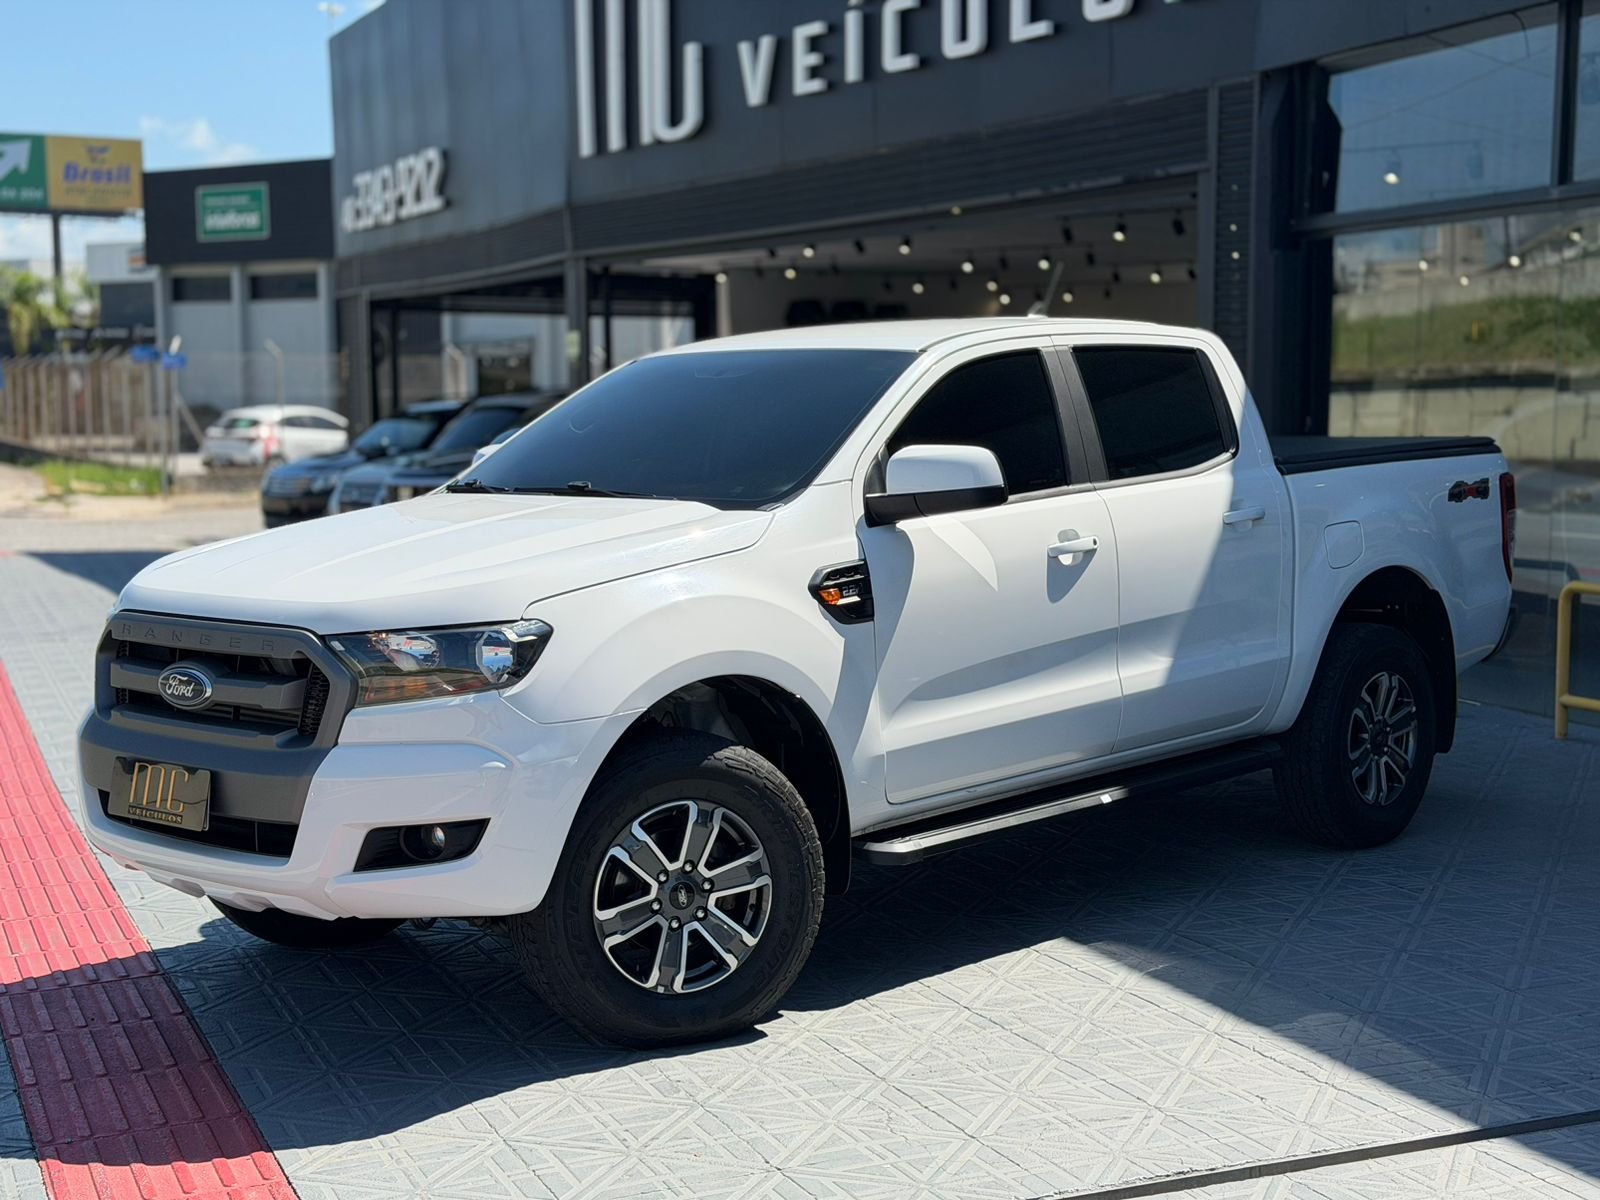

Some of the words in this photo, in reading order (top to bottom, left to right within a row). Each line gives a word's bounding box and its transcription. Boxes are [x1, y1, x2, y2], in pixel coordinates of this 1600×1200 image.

[737, 0, 1181, 107] VEÍCUL
[122, 624, 273, 651] RANGER
[165, 673, 194, 698] Ford
